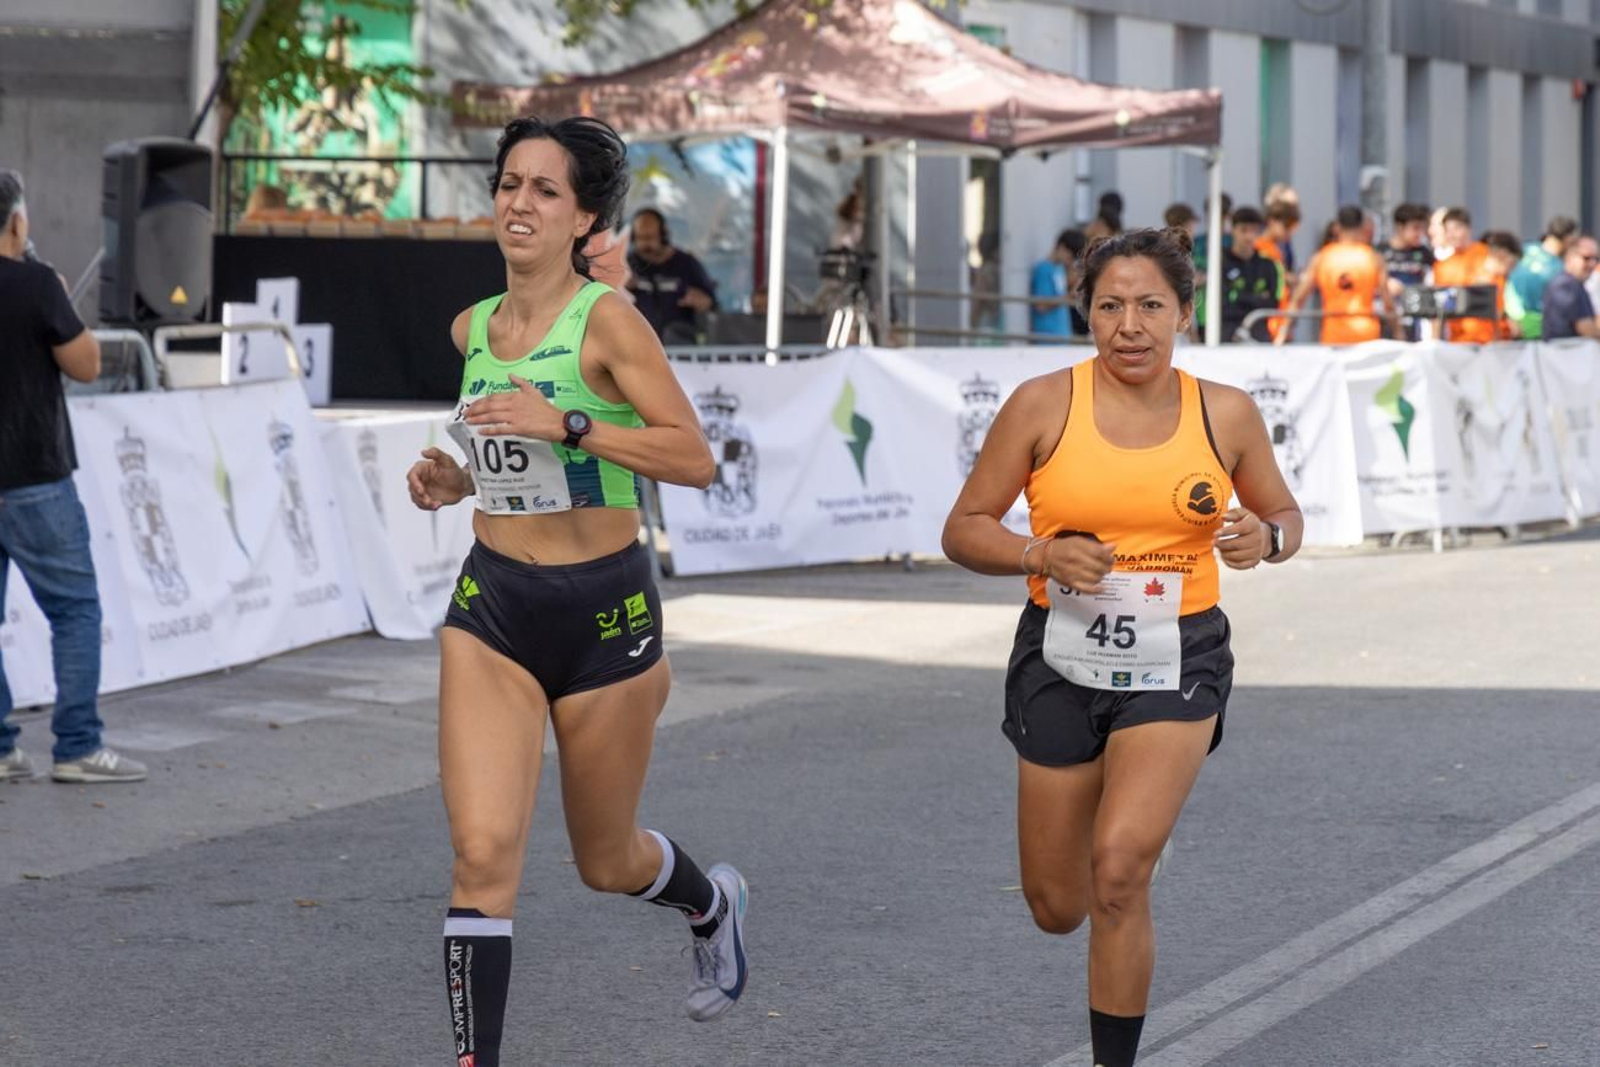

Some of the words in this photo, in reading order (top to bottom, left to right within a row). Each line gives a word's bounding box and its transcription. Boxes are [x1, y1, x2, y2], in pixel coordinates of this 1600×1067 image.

[239, 333, 249, 375] 2
[303, 338, 315, 378] 3
[470, 437, 530, 475] 105
[1085, 613, 1137, 650] 45
